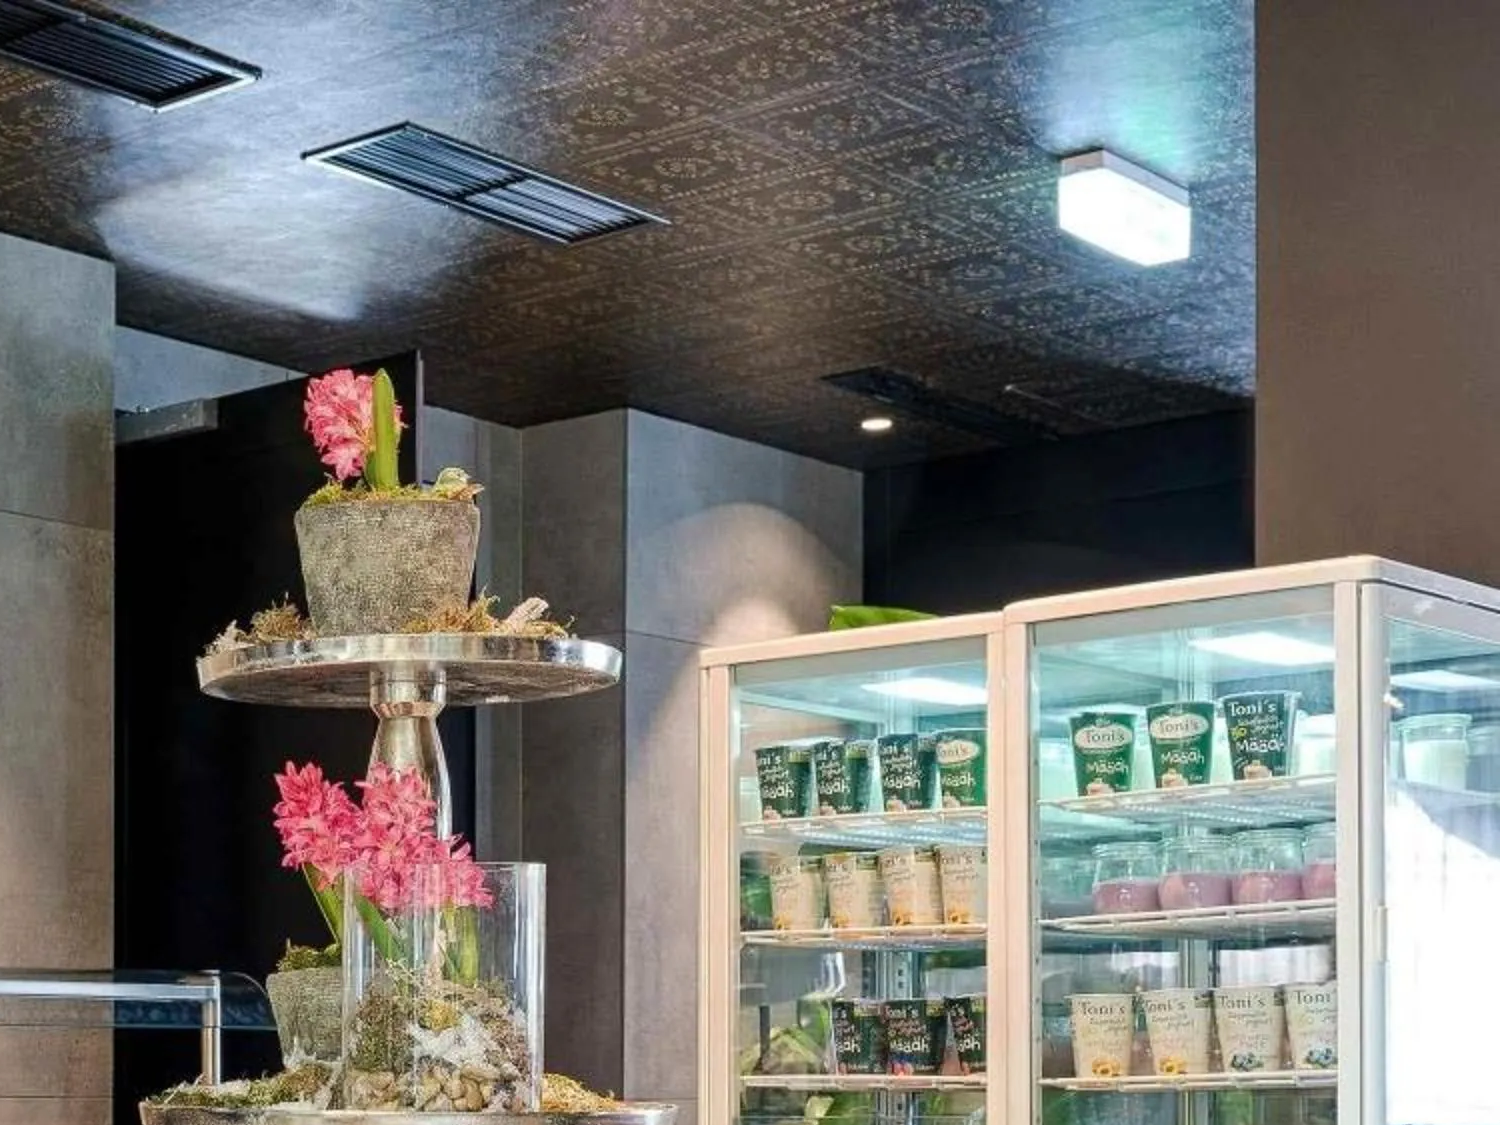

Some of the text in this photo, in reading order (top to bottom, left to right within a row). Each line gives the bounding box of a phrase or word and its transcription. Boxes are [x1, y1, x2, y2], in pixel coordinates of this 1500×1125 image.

[1227, 699, 1277, 717] Toni's
[1155, 717, 1201, 734] Toni's
[1082, 727, 1125, 743] Toni's
[1078, 1000, 1126, 1015] Toni's
[1217, 992, 1266, 1009] Toni's
